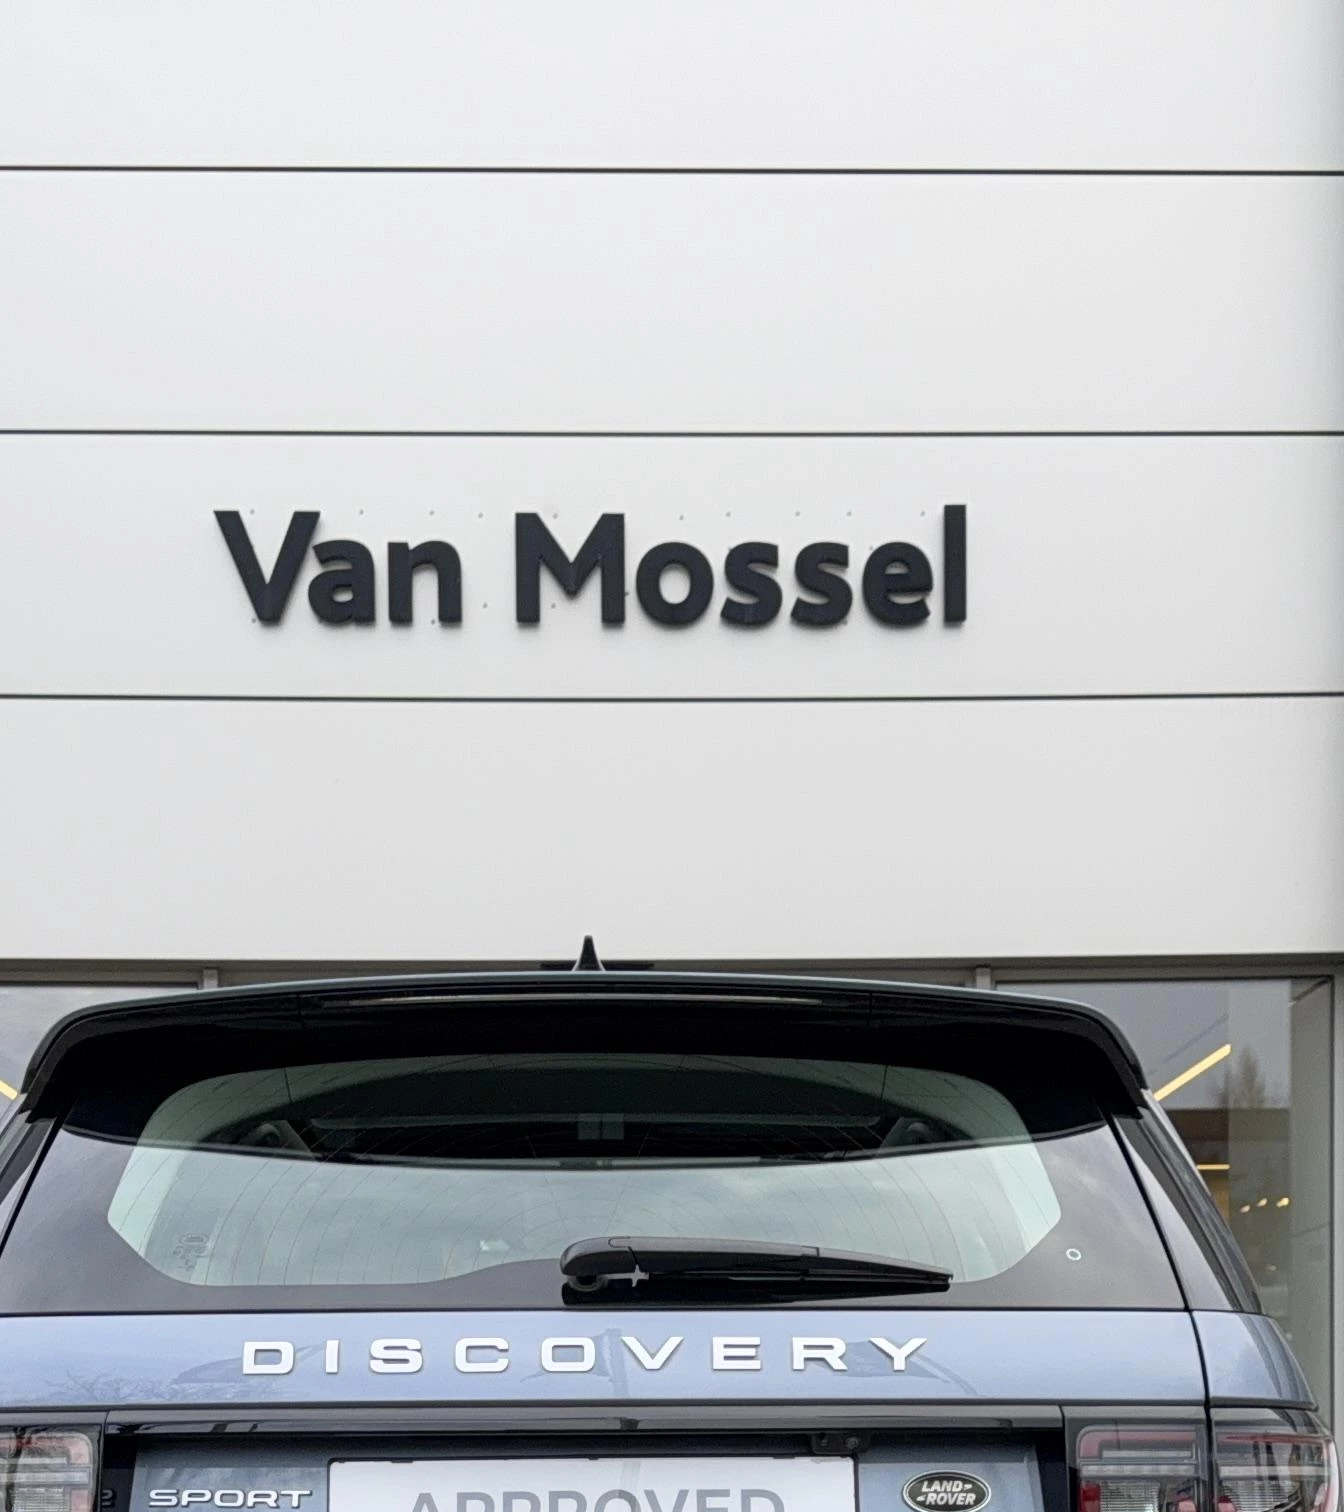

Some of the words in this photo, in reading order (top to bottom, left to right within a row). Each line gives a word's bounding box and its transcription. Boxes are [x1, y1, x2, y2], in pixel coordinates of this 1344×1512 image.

[214, 510, 463, 627] Van
[515, 504, 967, 628] Mossel
[242, 1335, 930, 1376] DISCOVERY
[921, 1480, 963, 1492] LAND
[149, 1489, 312, 1508] SPORT
[925, 1493, 977, 1505] ROVER
